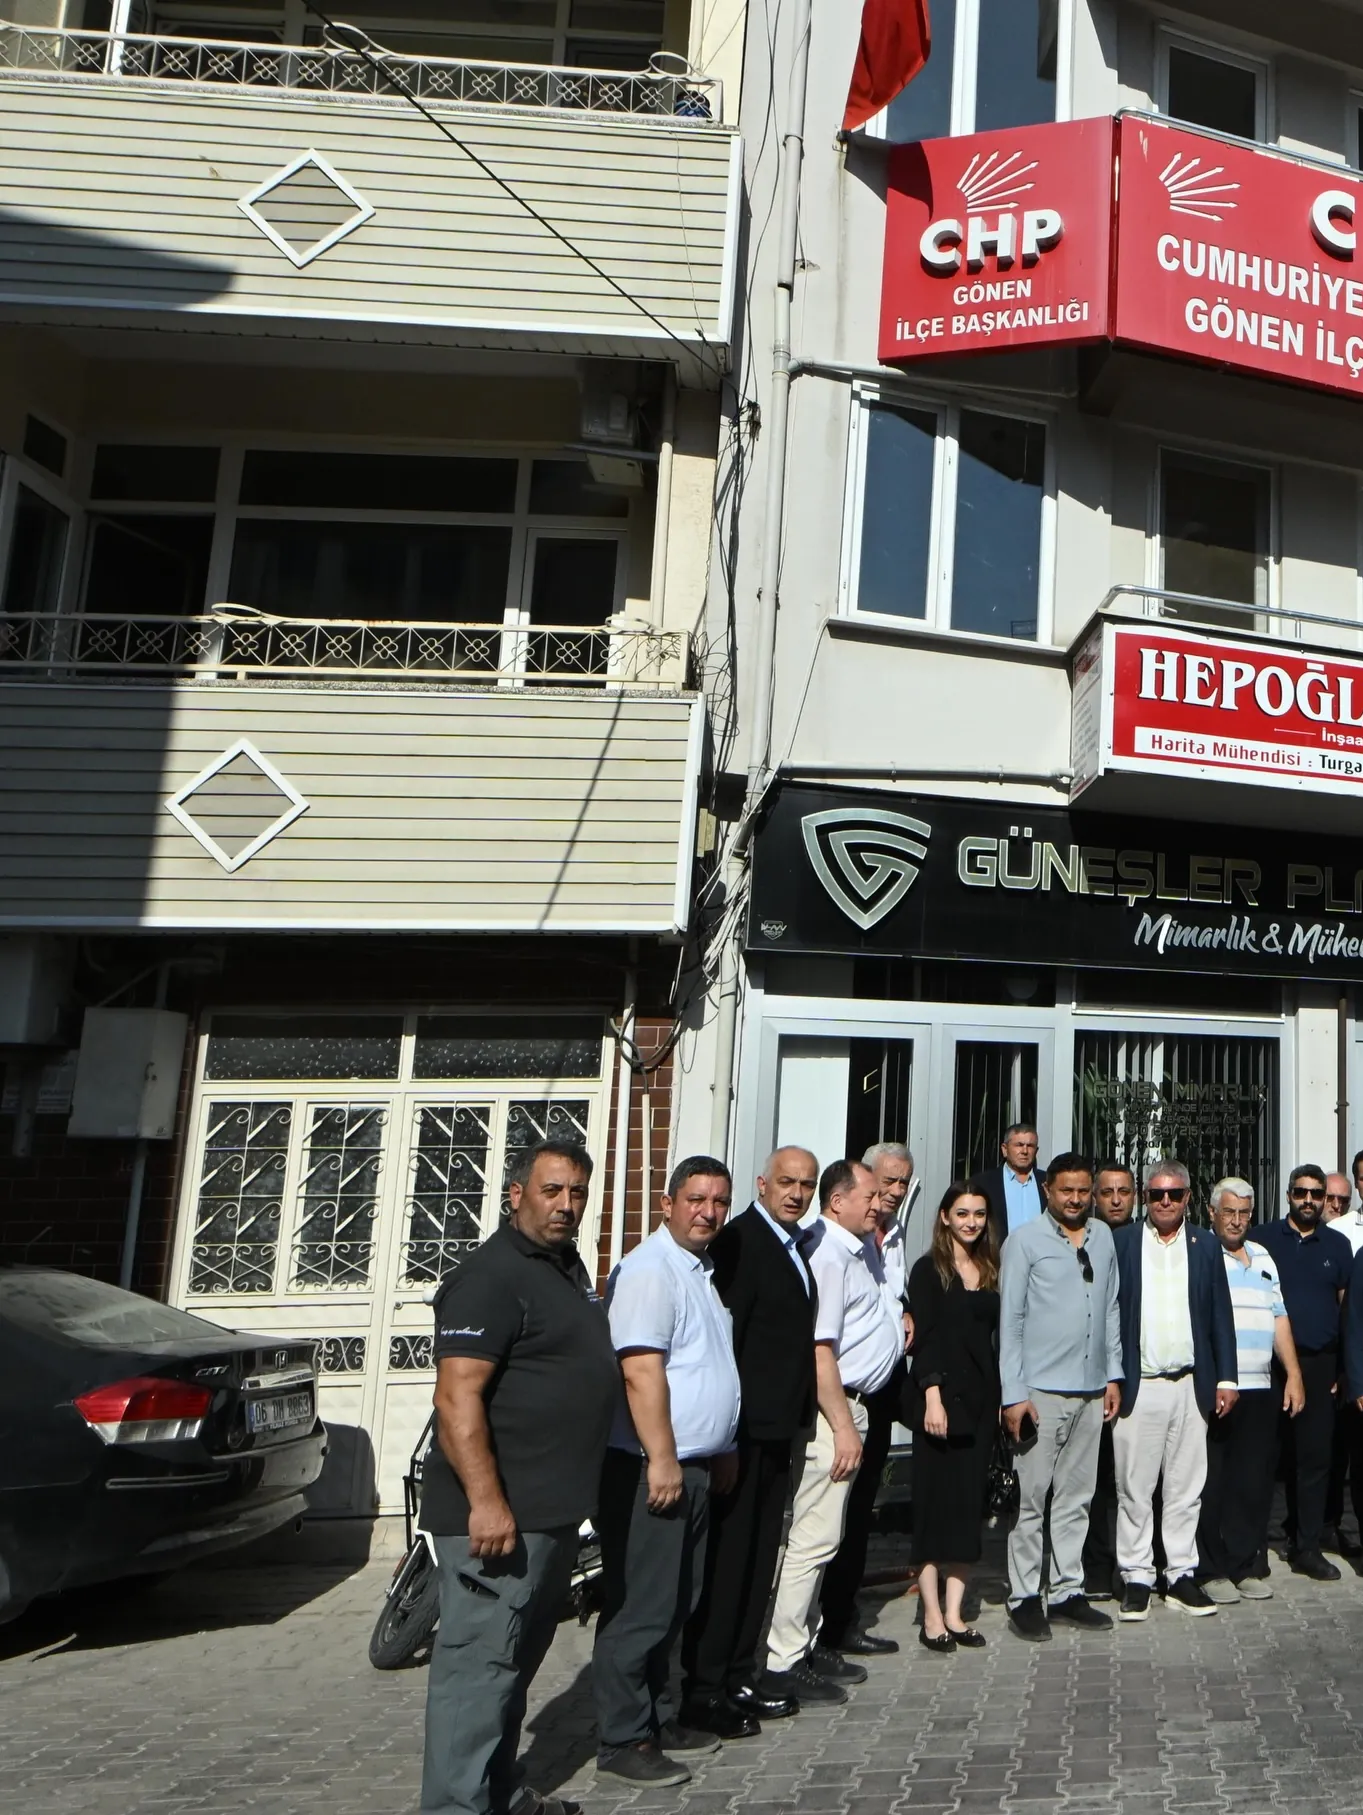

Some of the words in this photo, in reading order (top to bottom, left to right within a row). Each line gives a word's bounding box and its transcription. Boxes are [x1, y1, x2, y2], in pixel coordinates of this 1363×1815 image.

[919, 208, 1064, 268] CHP
[953, 278, 1032, 305] GÖNEN
[896, 317, 945, 343] İLÇE
[952, 299, 1089, 336] BAŞKANLIĞI
[1185, 297, 1303, 356] GÖNEN
[1151, 734, 1206, 755] Harita
[1213, 740, 1301, 766] Mühendisi
[957, 825, 1262, 907] GÜNEŞLER
[1133, 912, 1260, 955] Mimarlık
[1262, 929, 1284, 953] &
[1093, 1077, 1163, 1100] GÖNEN
[255, 1402, 268, 1424] 06
